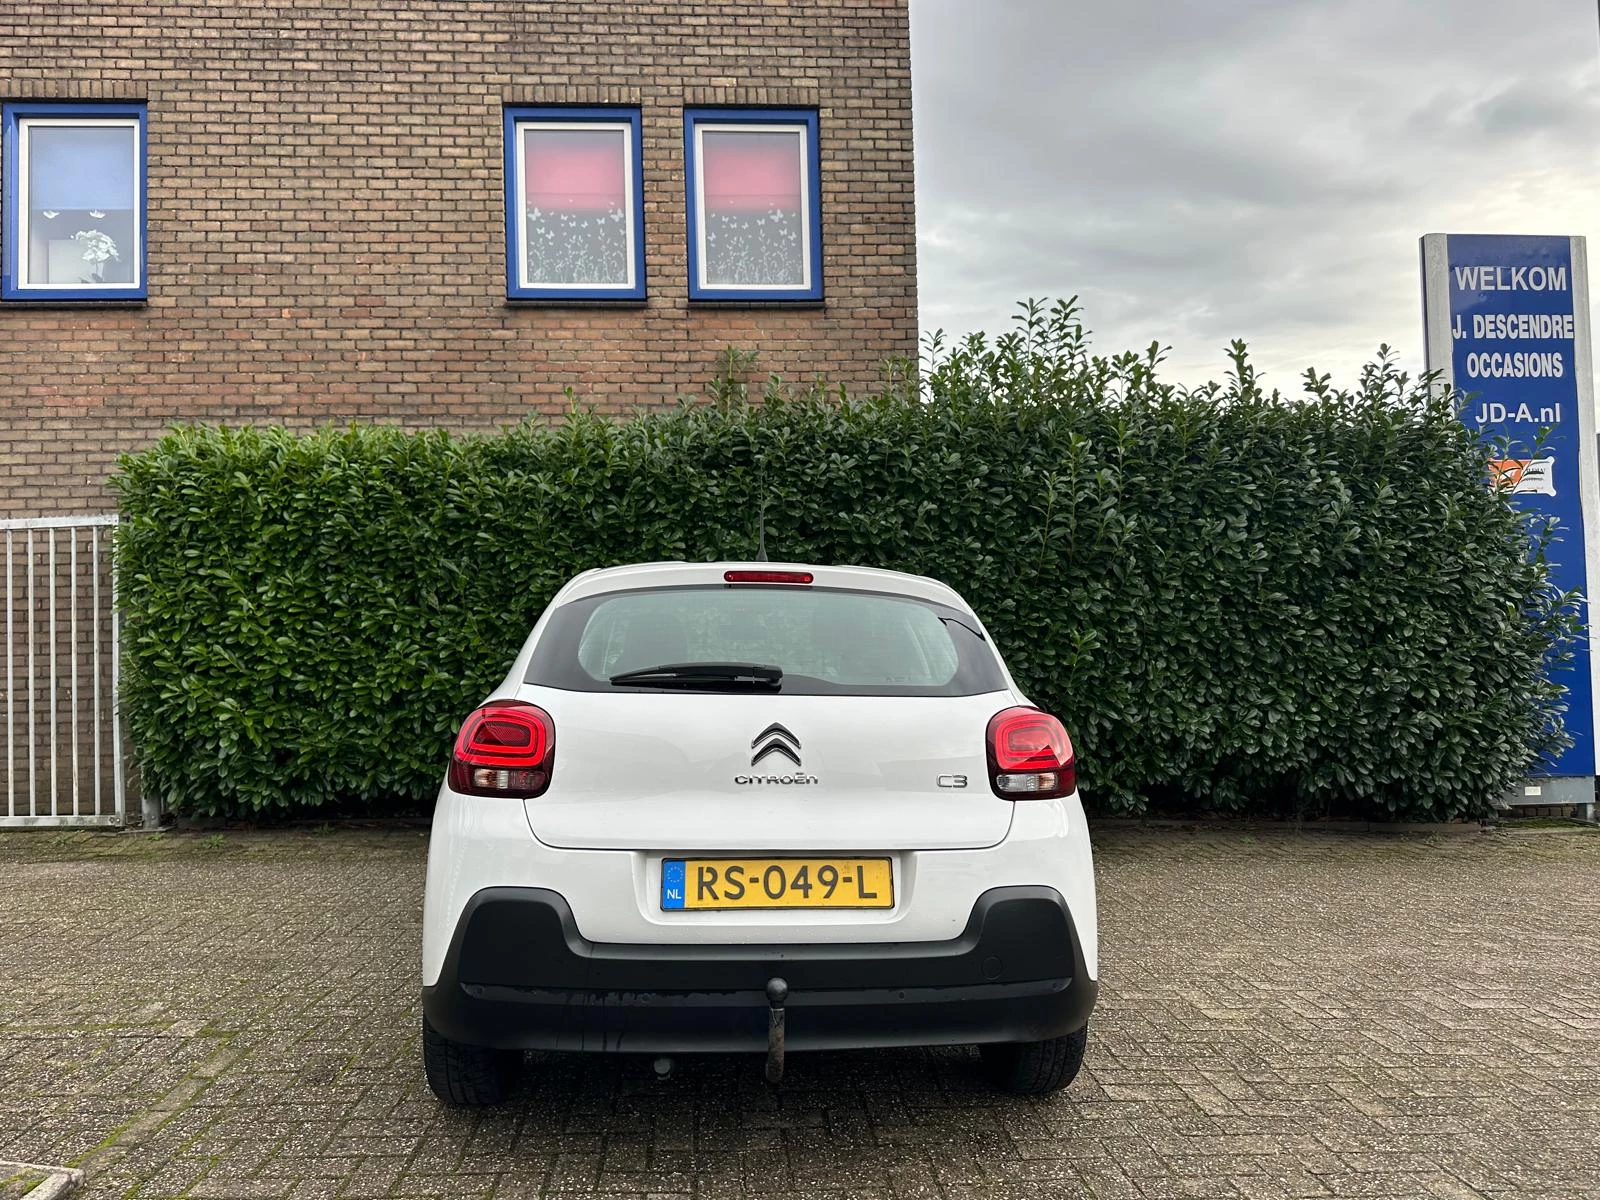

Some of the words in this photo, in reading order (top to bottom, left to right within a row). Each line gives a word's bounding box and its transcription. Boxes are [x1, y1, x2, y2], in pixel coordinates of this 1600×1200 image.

[1455, 267, 1567, 291] WELKOM
[1452, 315, 1467, 339] J.
[1473, 314, 1574, 339] DESCENDRE
[1467, 352, 1563, 377] OCCASIONS
[1475, 403, 1561, 423] JD-A.nl
[936, 774, 968, 788] C3
[666, 889, 682, 899] NL
[697, 865, 878, 900] RS-049-L
